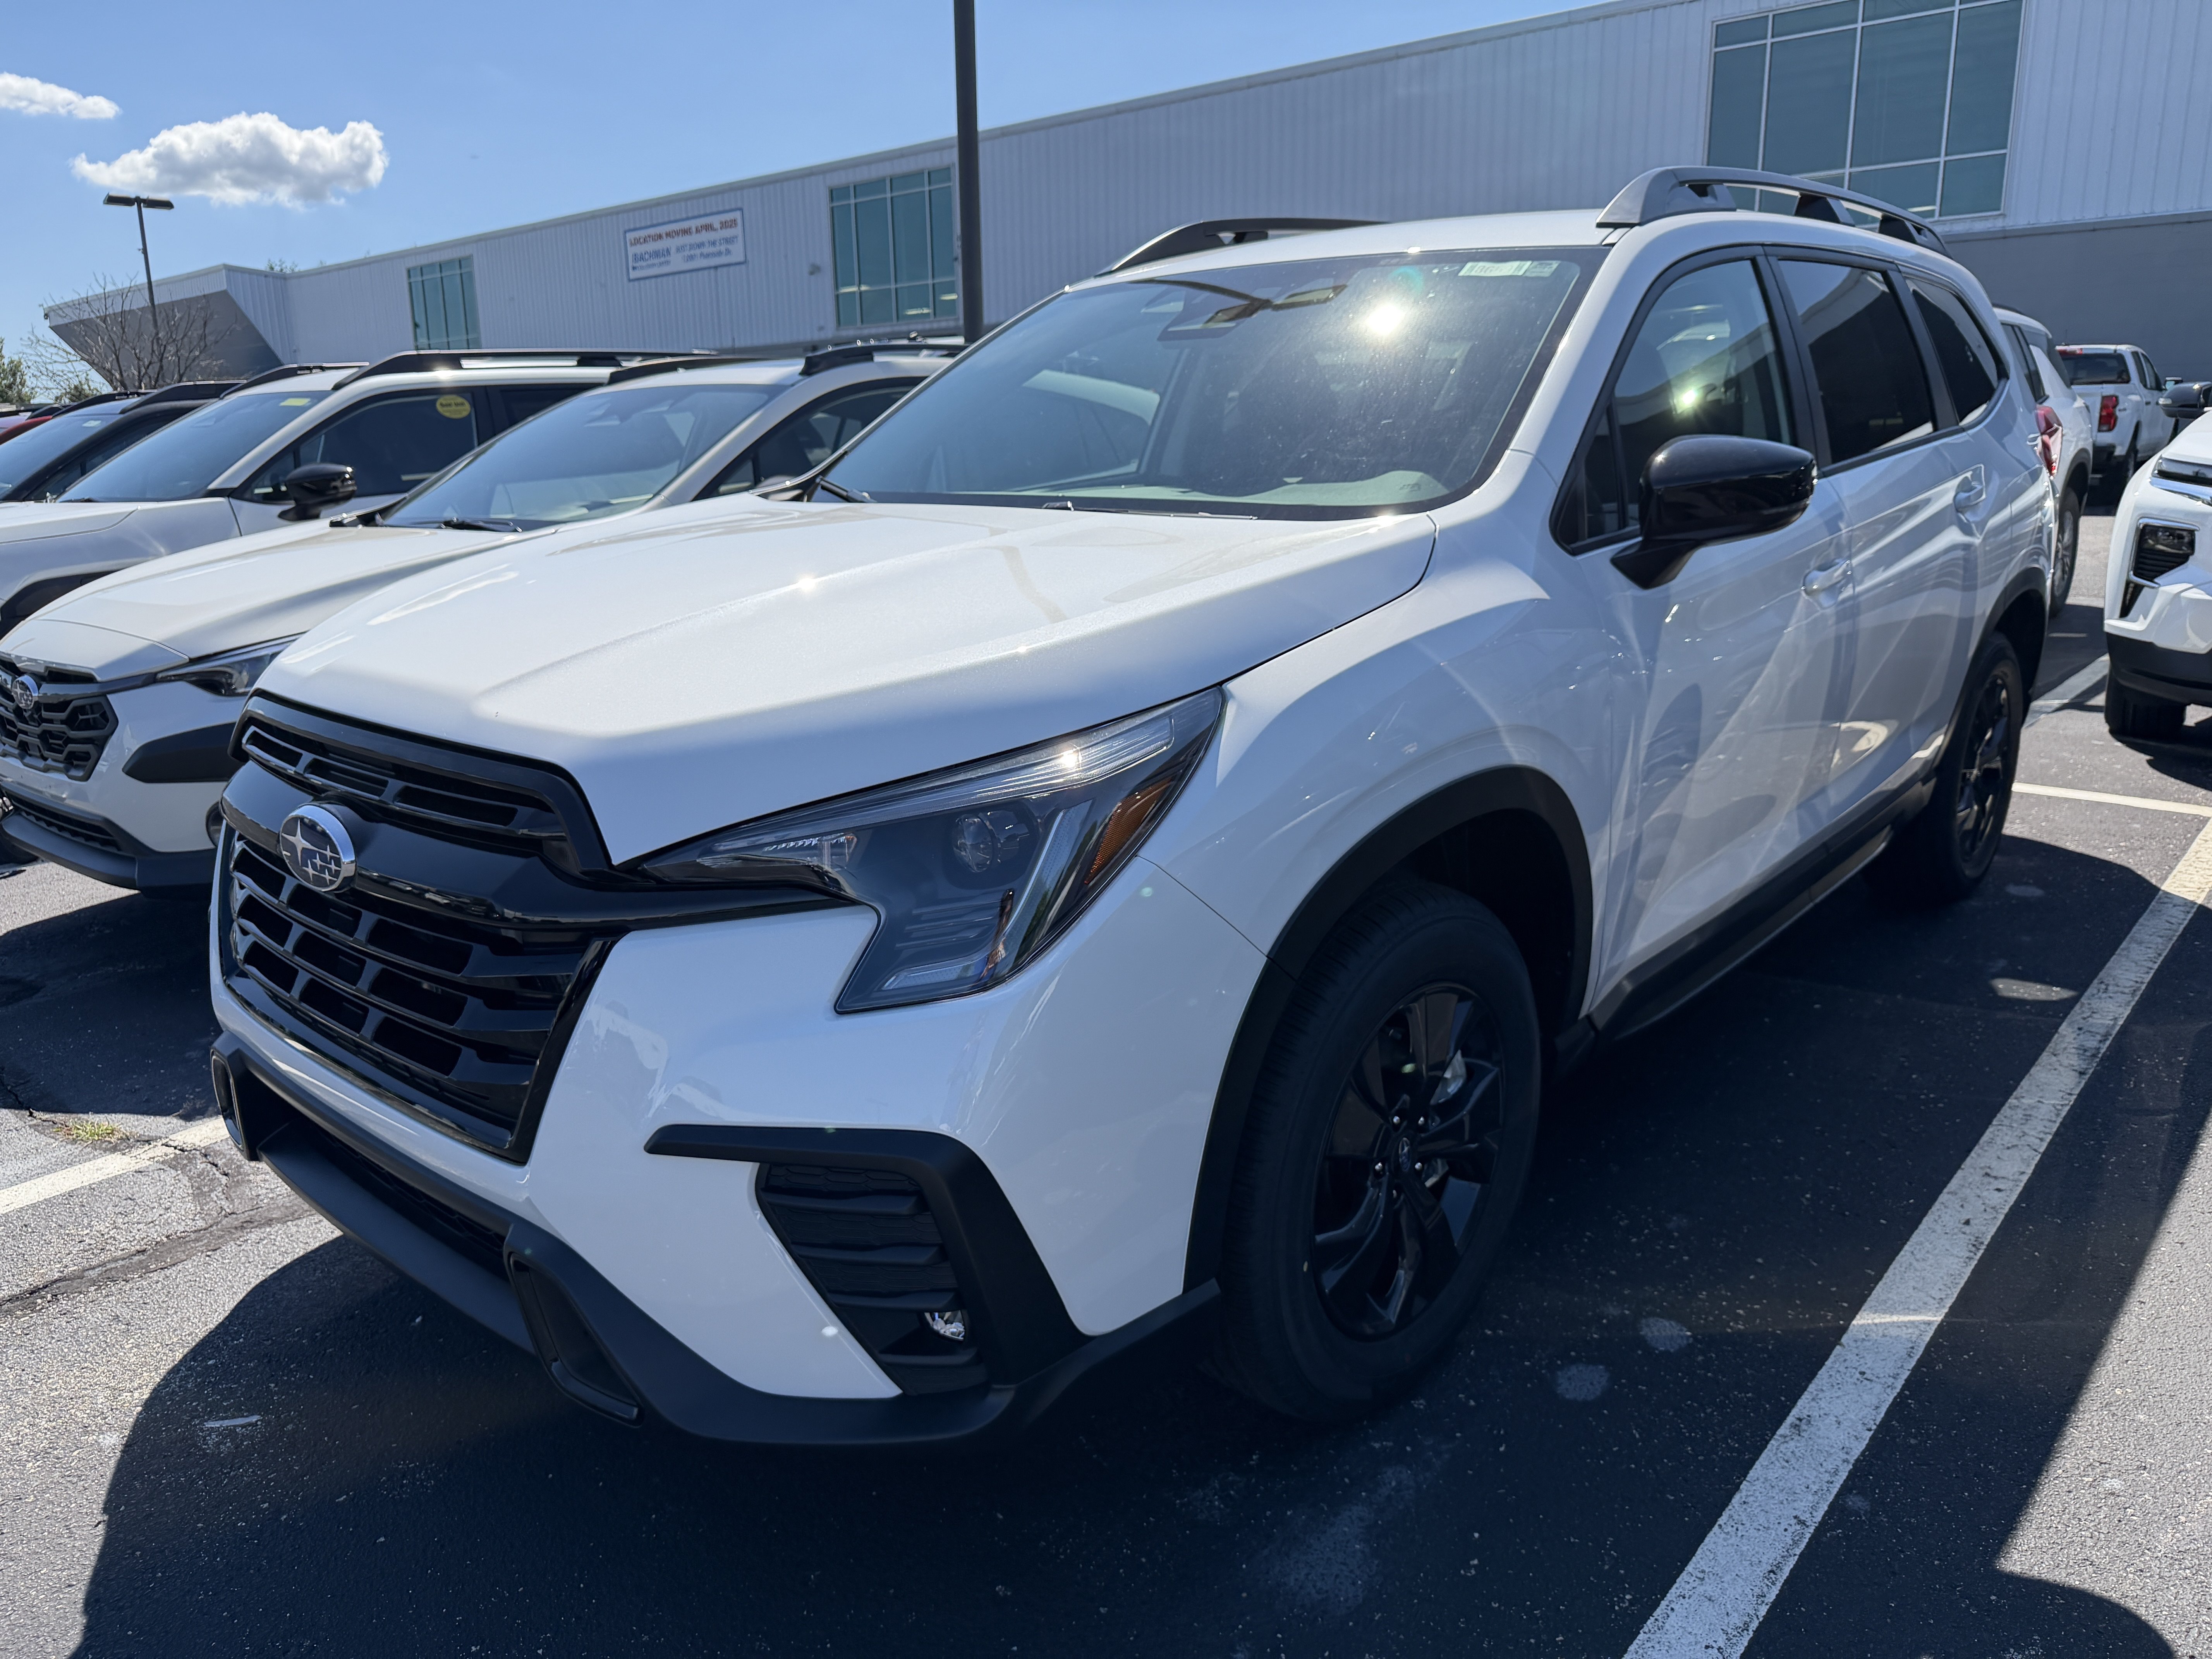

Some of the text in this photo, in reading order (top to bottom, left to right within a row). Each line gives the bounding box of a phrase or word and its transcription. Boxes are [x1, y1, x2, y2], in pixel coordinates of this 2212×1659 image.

[628, 233, 663, 247] LOCATION
[665, 227, 692, 239] MOVING
[717, 235, 738, 246] STREET
[634, 246, 671, 263] BACHMAN
